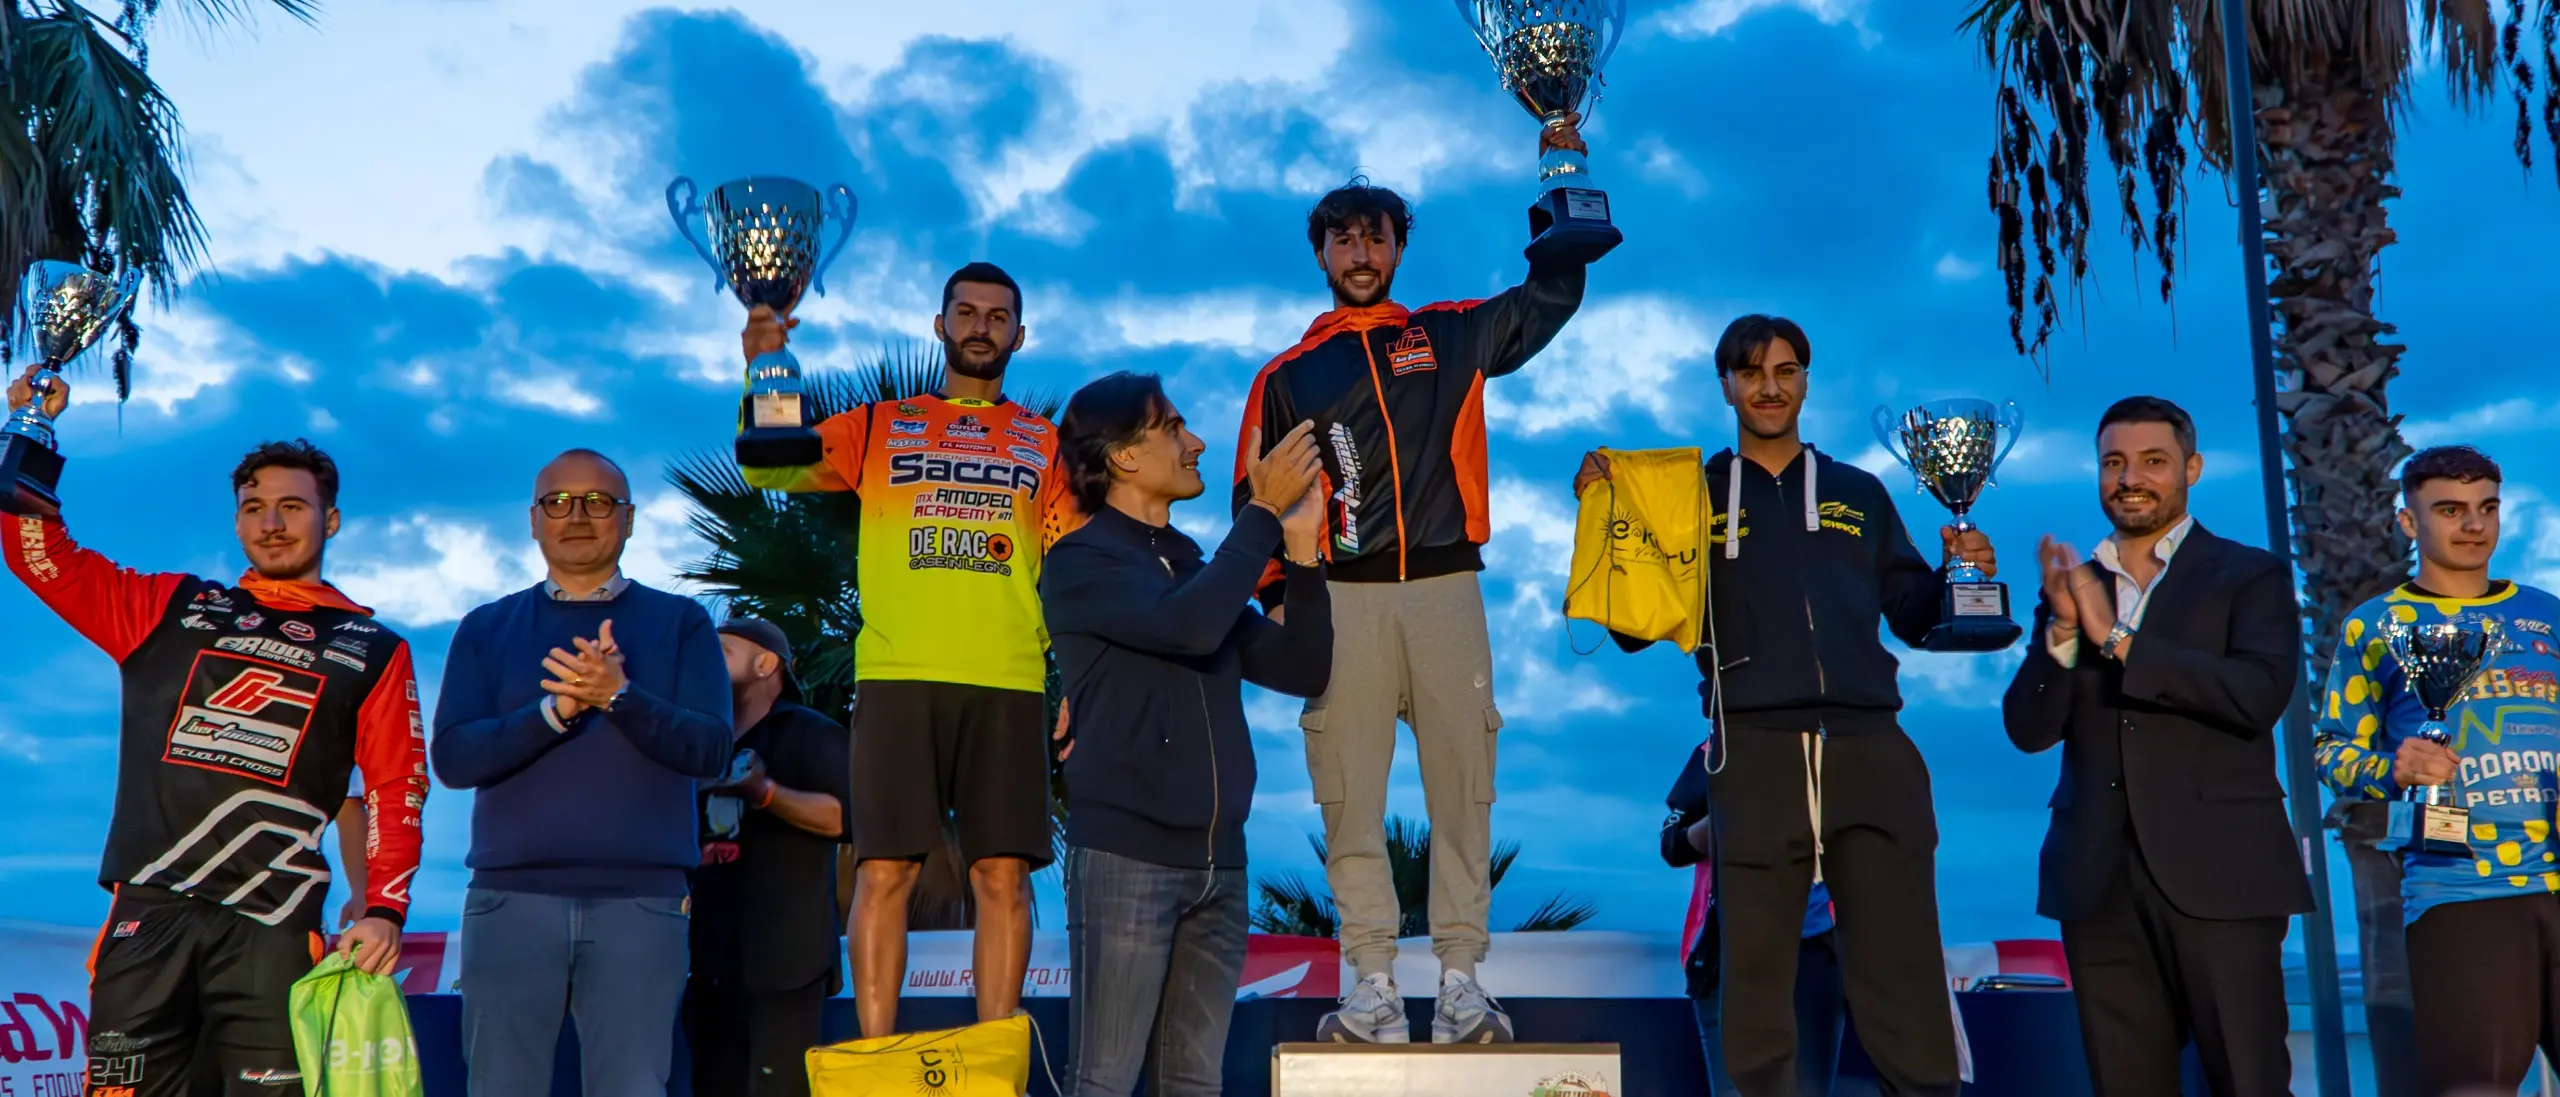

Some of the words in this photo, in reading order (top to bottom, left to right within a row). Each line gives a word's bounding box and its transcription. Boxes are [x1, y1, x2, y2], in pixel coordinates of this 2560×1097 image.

[949, 423, 983, 432] OUTLET
[926, 453, 971, 462] RACING
[977, 456, 1013, 466] TEAM
[916, 494, 933, 503] MX
[914, 505, 996, 521] ACADEMY
[910, 526, 937, 557] DE
[910, 556, 947, 570] CASE
[948, 557, 962, 569] IN
[964, 558, 1011, 576] LEGNO
[171, 746, 224, 762] SCUOLA
[228, 755, 284, 777] CROSS
[2460, 750, 2560, 787] CORON
[90, 1054, 145, 1085] 241
